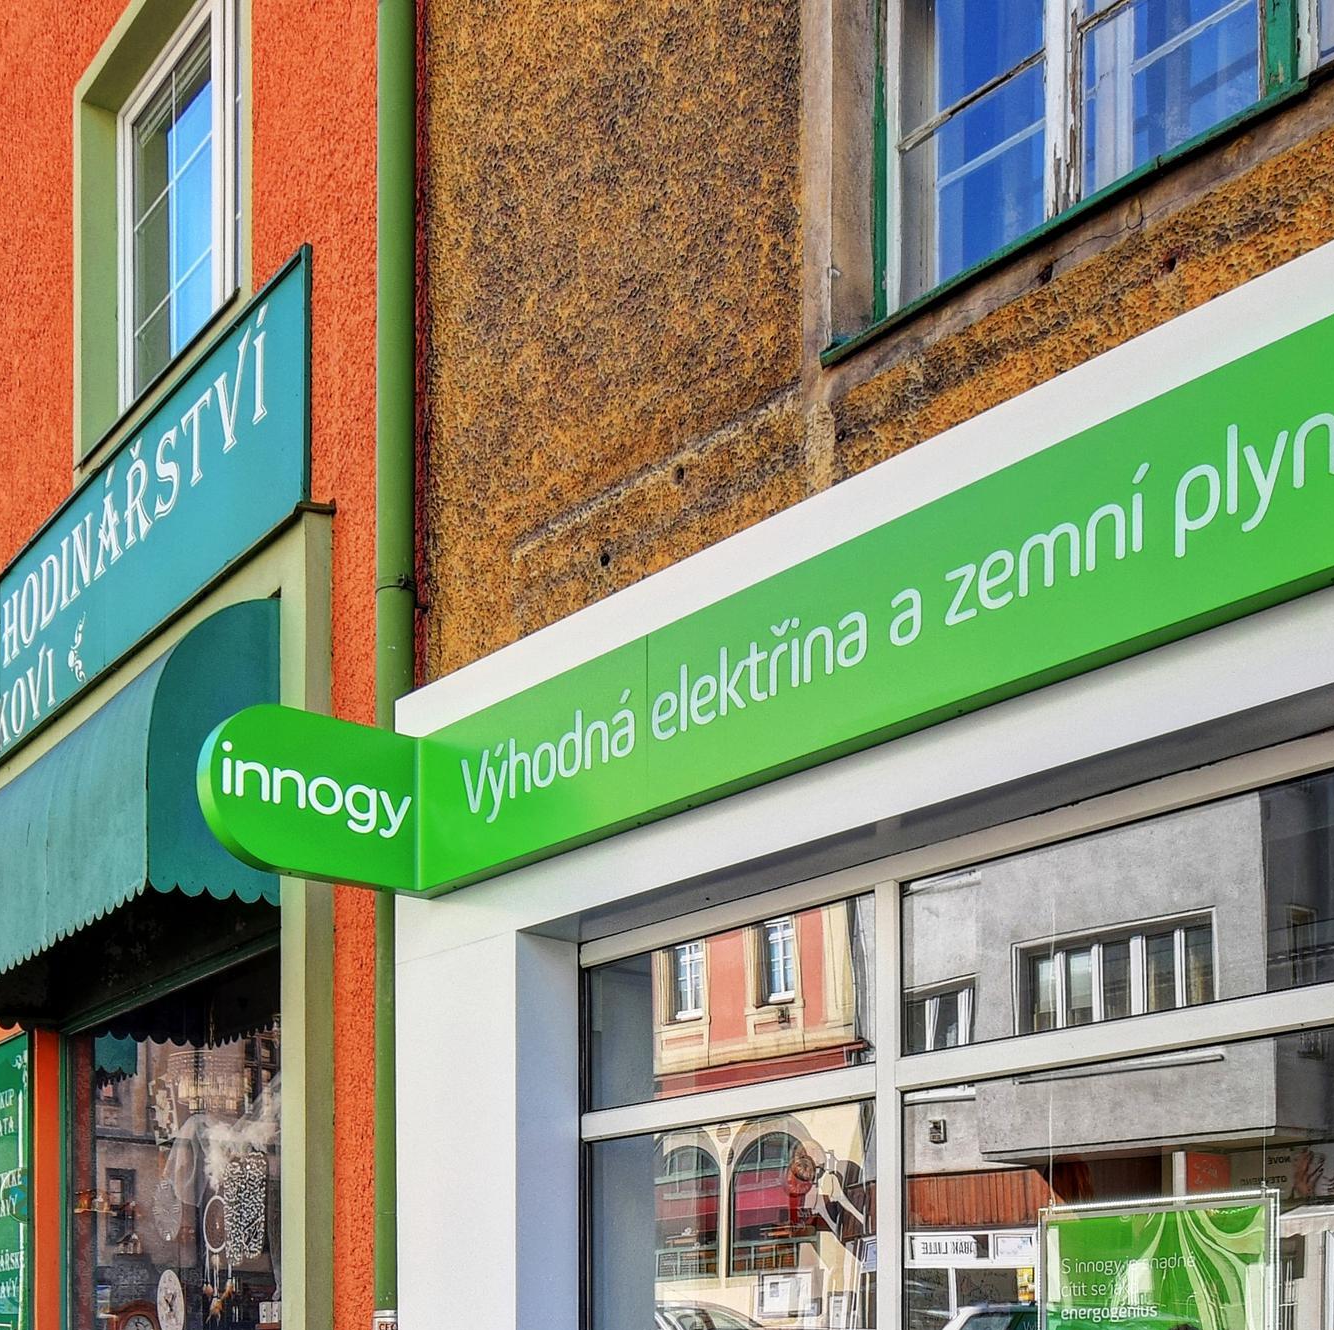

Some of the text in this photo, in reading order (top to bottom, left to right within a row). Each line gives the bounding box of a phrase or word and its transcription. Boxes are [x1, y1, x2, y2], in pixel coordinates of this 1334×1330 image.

[2, 303, 268, 668] HODINÁŘSTVÍ
[461, 688, 636, 823] Výhodná
[651, 619, 867, 741] elektřina
[889, 587, 922, 647] a
[945, 461, 1145, 624] zemní
[222, 740, 412, 839] innogy
[1061, 1257, 1071, 1274] S
[1075, 1257, 1120, 1275] innogy
[1142, 1252, 1196, 1270] nadné
[1061, 1281, 1088, 1298] cítit
[1091, 1284, 1106, 1297] se
